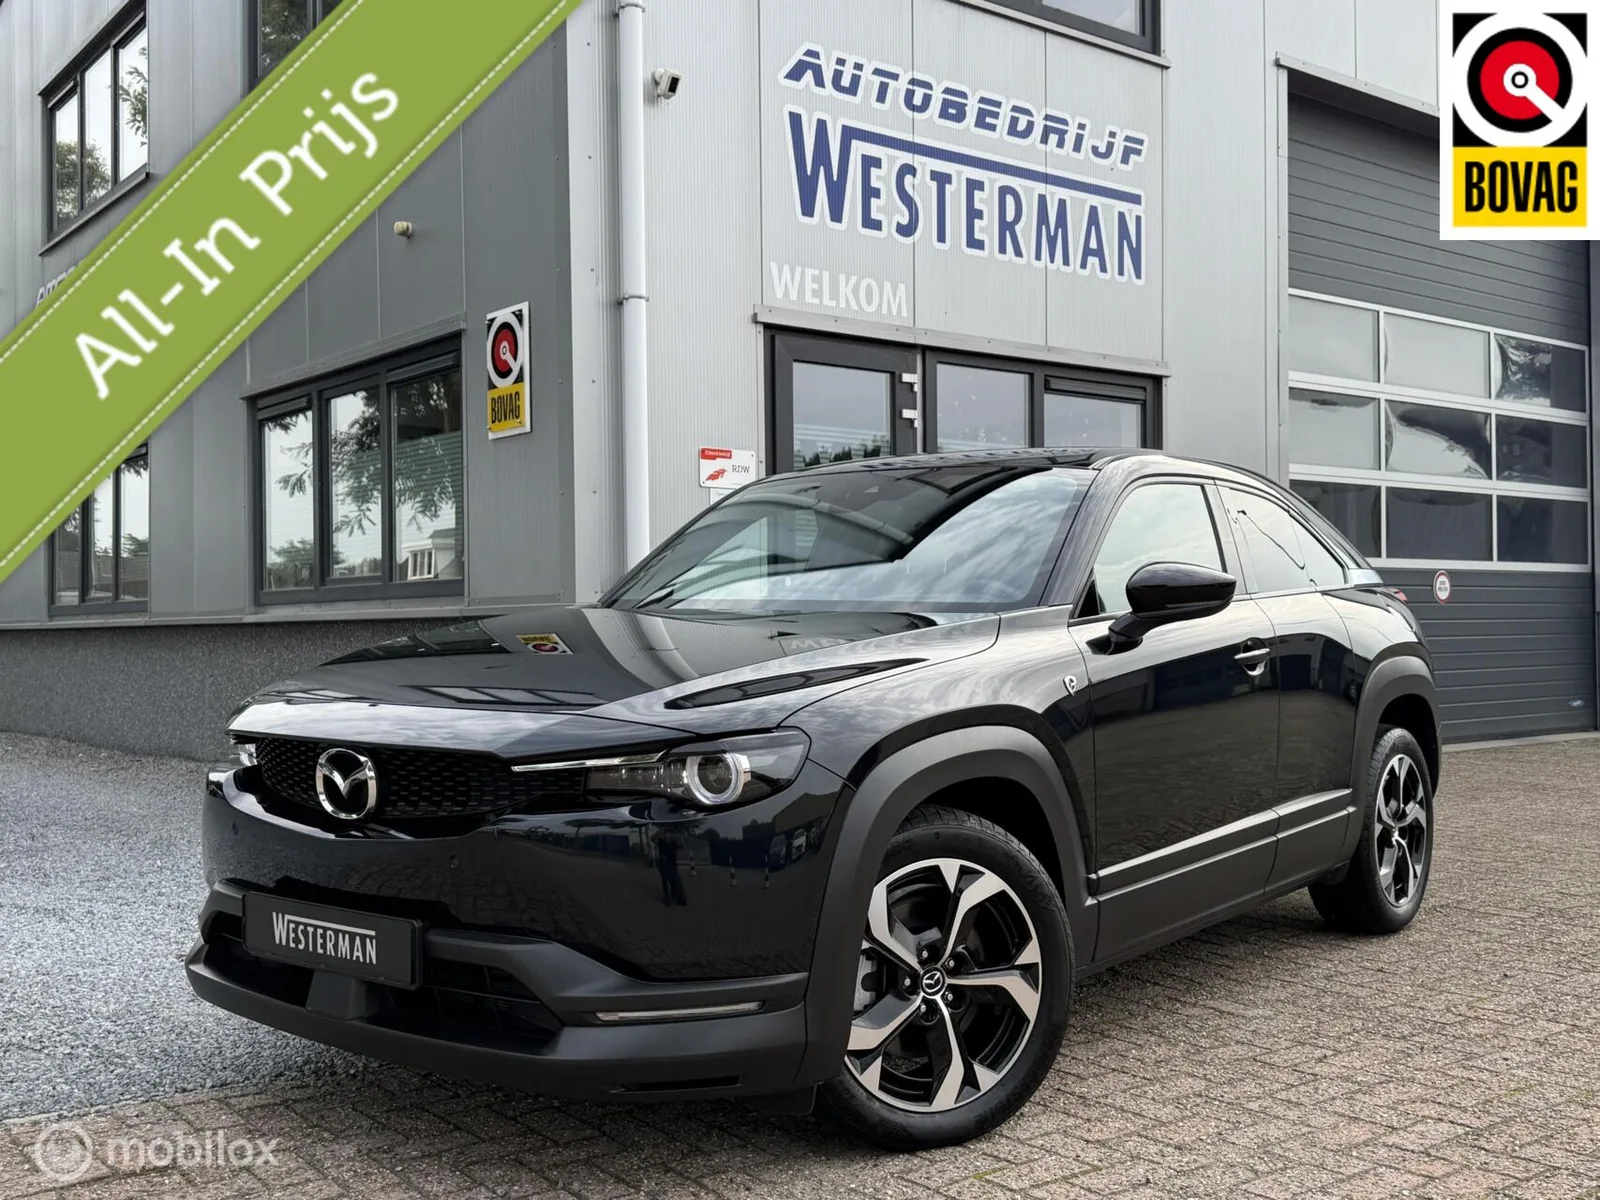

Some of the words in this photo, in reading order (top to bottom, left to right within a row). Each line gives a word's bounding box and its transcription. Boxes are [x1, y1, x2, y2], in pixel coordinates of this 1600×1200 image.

[783, 49, 1146, 167] AUTOBEDRIJF
[788, 111, 1143, 280] WESTERMAN
[770, 262, 908, 317] WELKOM
[491, 391, 520, 424] BOVAG
[732, 464, 751, 473] RDW
[272, 911, 377, 965] WESTERMAN
